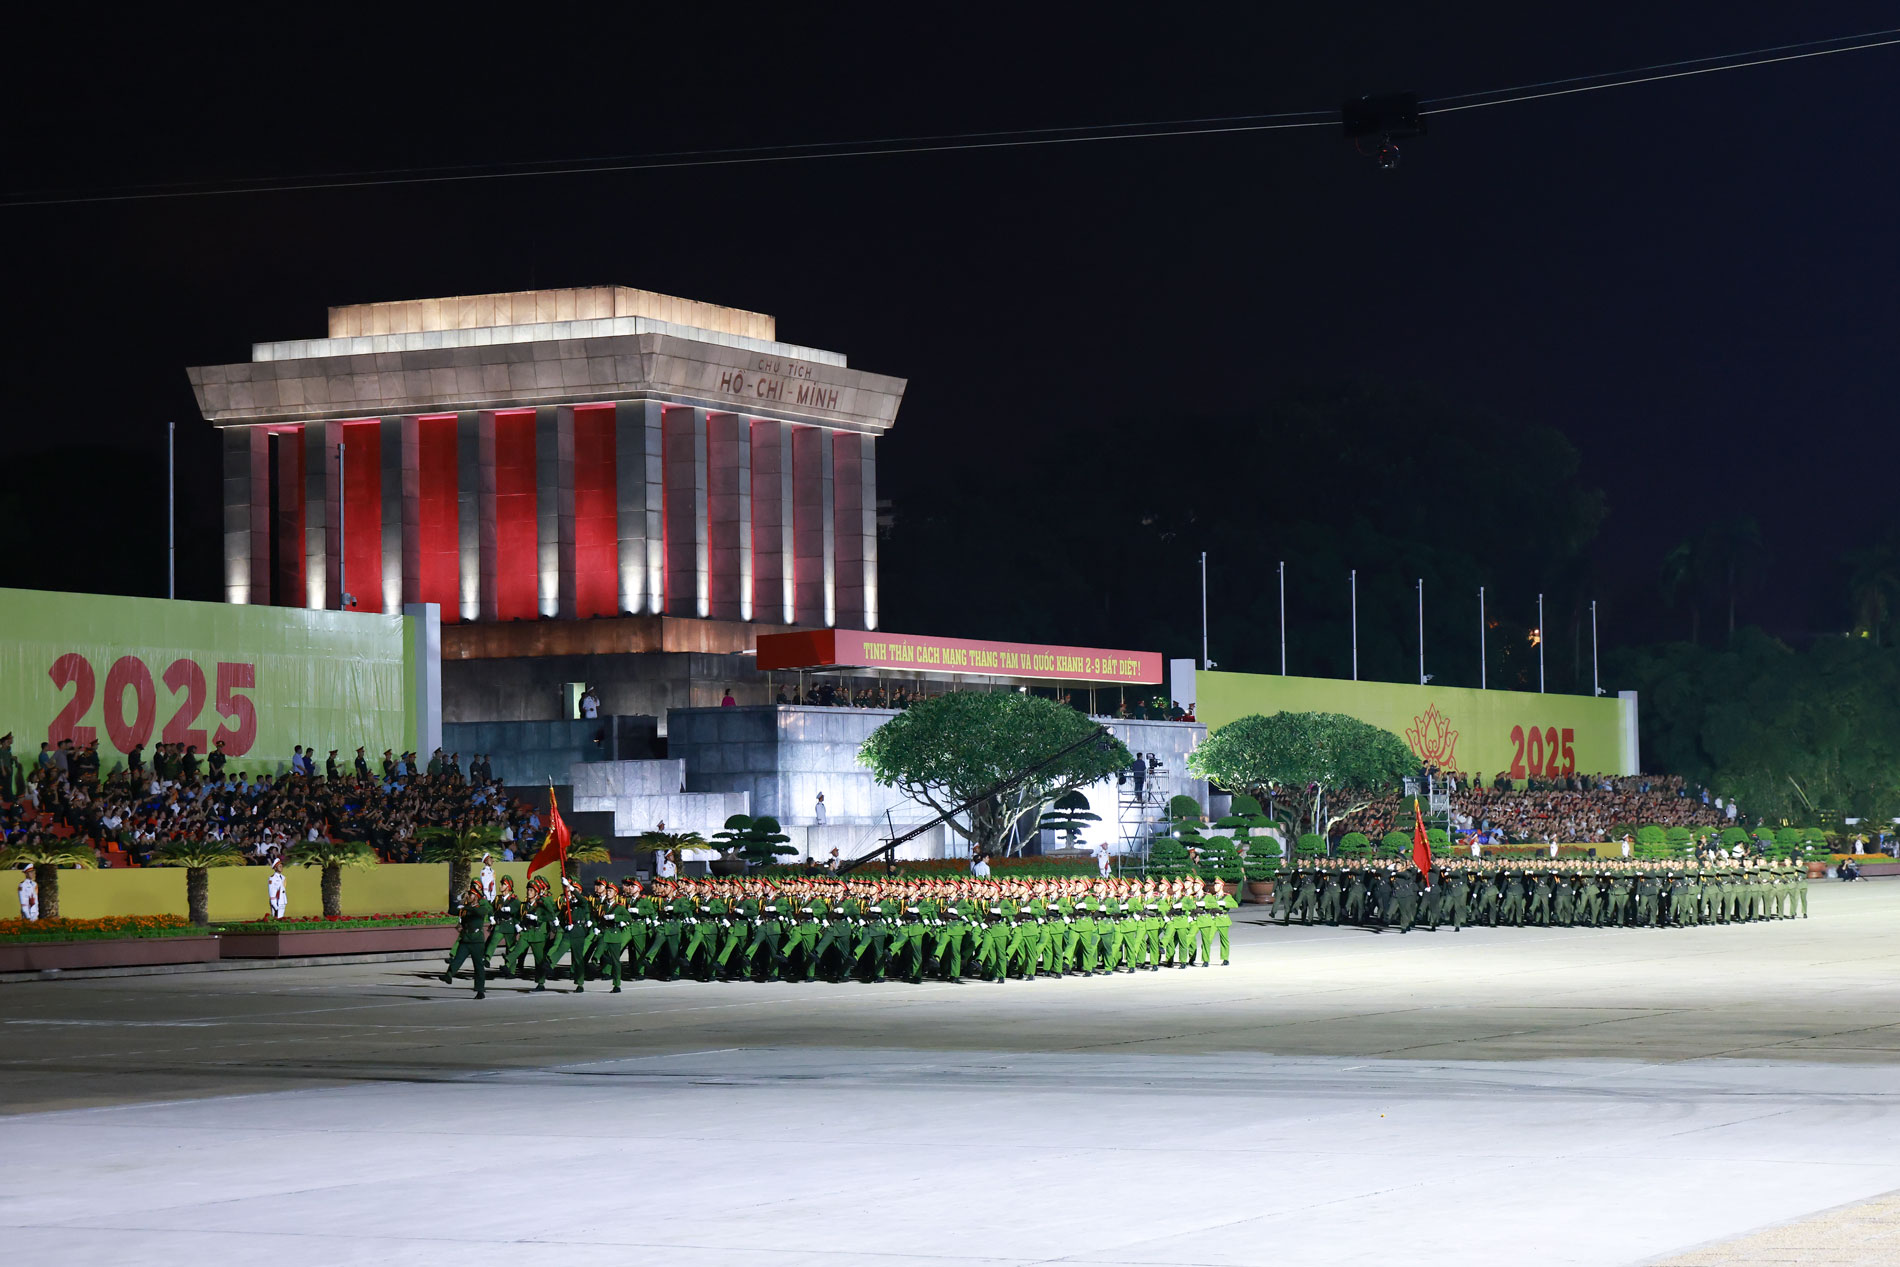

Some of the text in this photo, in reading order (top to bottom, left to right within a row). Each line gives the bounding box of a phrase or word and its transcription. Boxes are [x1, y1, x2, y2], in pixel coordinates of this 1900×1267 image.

[863, 642, 887, 661] TINH
[916, 643, 940, 664] CÁCH
[942, 647, 967, 668] MẠNG
[969, 647, 998, 668] THÁNG
[1000, 649, 1018, 669] TÁM
[1033, 650, 1055, 671] QUỐC
[1056, 653, 1084, 673] KHÁNH
[1085, 657, 1100, 674] 2-9
[1102, 655, 1118, 675] BẤT
[48, 652, 257, 757] 2025
[1510, 725, 1575, 779] 2025
